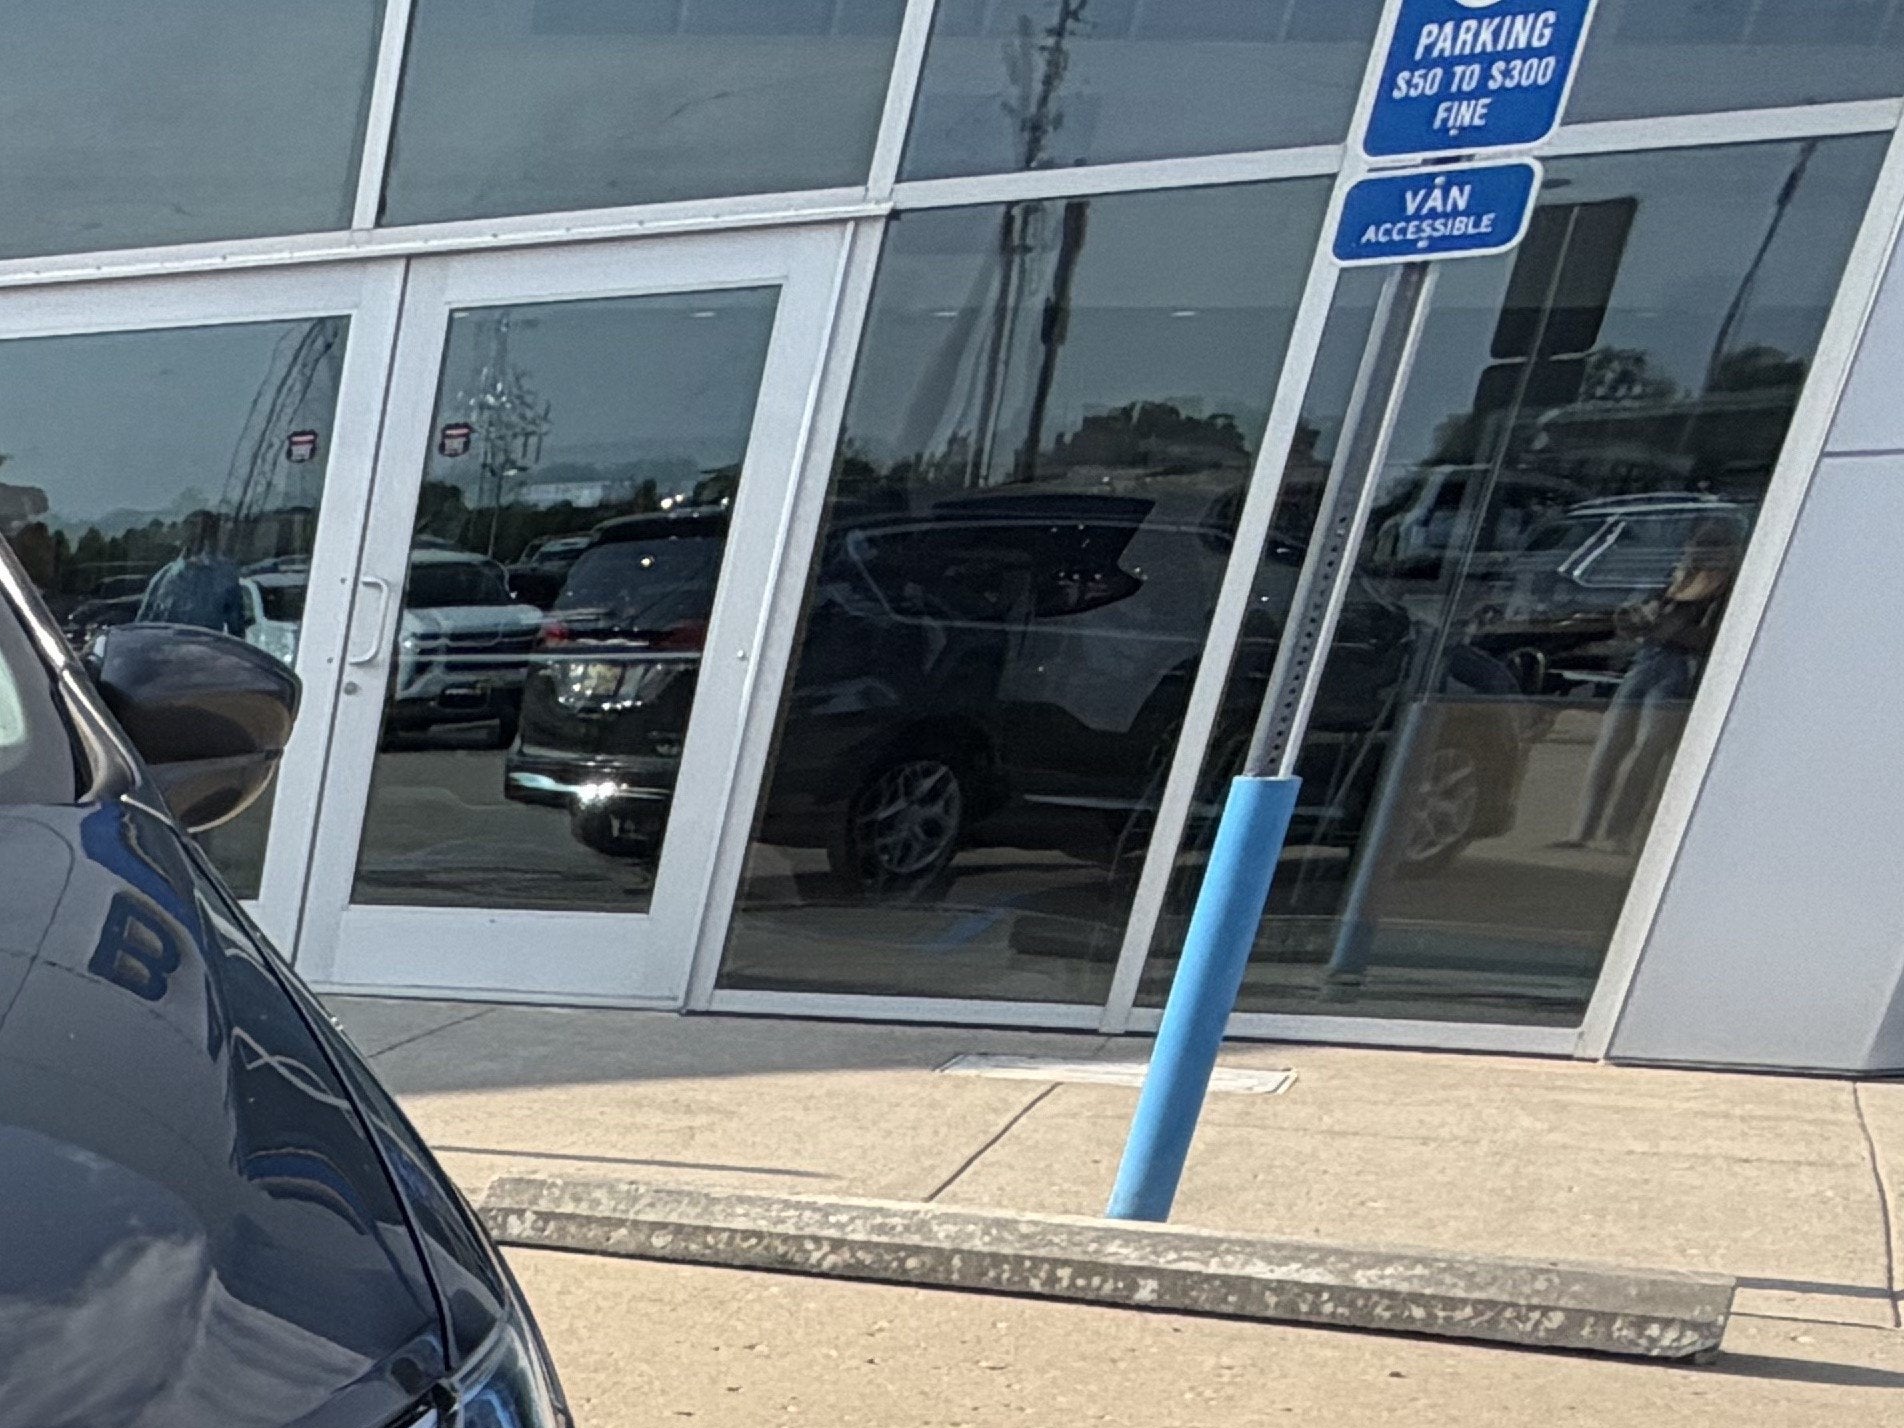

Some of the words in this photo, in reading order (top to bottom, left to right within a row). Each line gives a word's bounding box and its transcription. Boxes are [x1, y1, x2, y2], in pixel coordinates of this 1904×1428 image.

[1414, 10, 1557, 61] PARKING
[1450, 63, 1481, 93] TO
[1432, 97, 1492, 130] FINE
[1404, 184, 1472, 216] VAN
[1360, 212, 1496, 244] ACCESSIBLE
